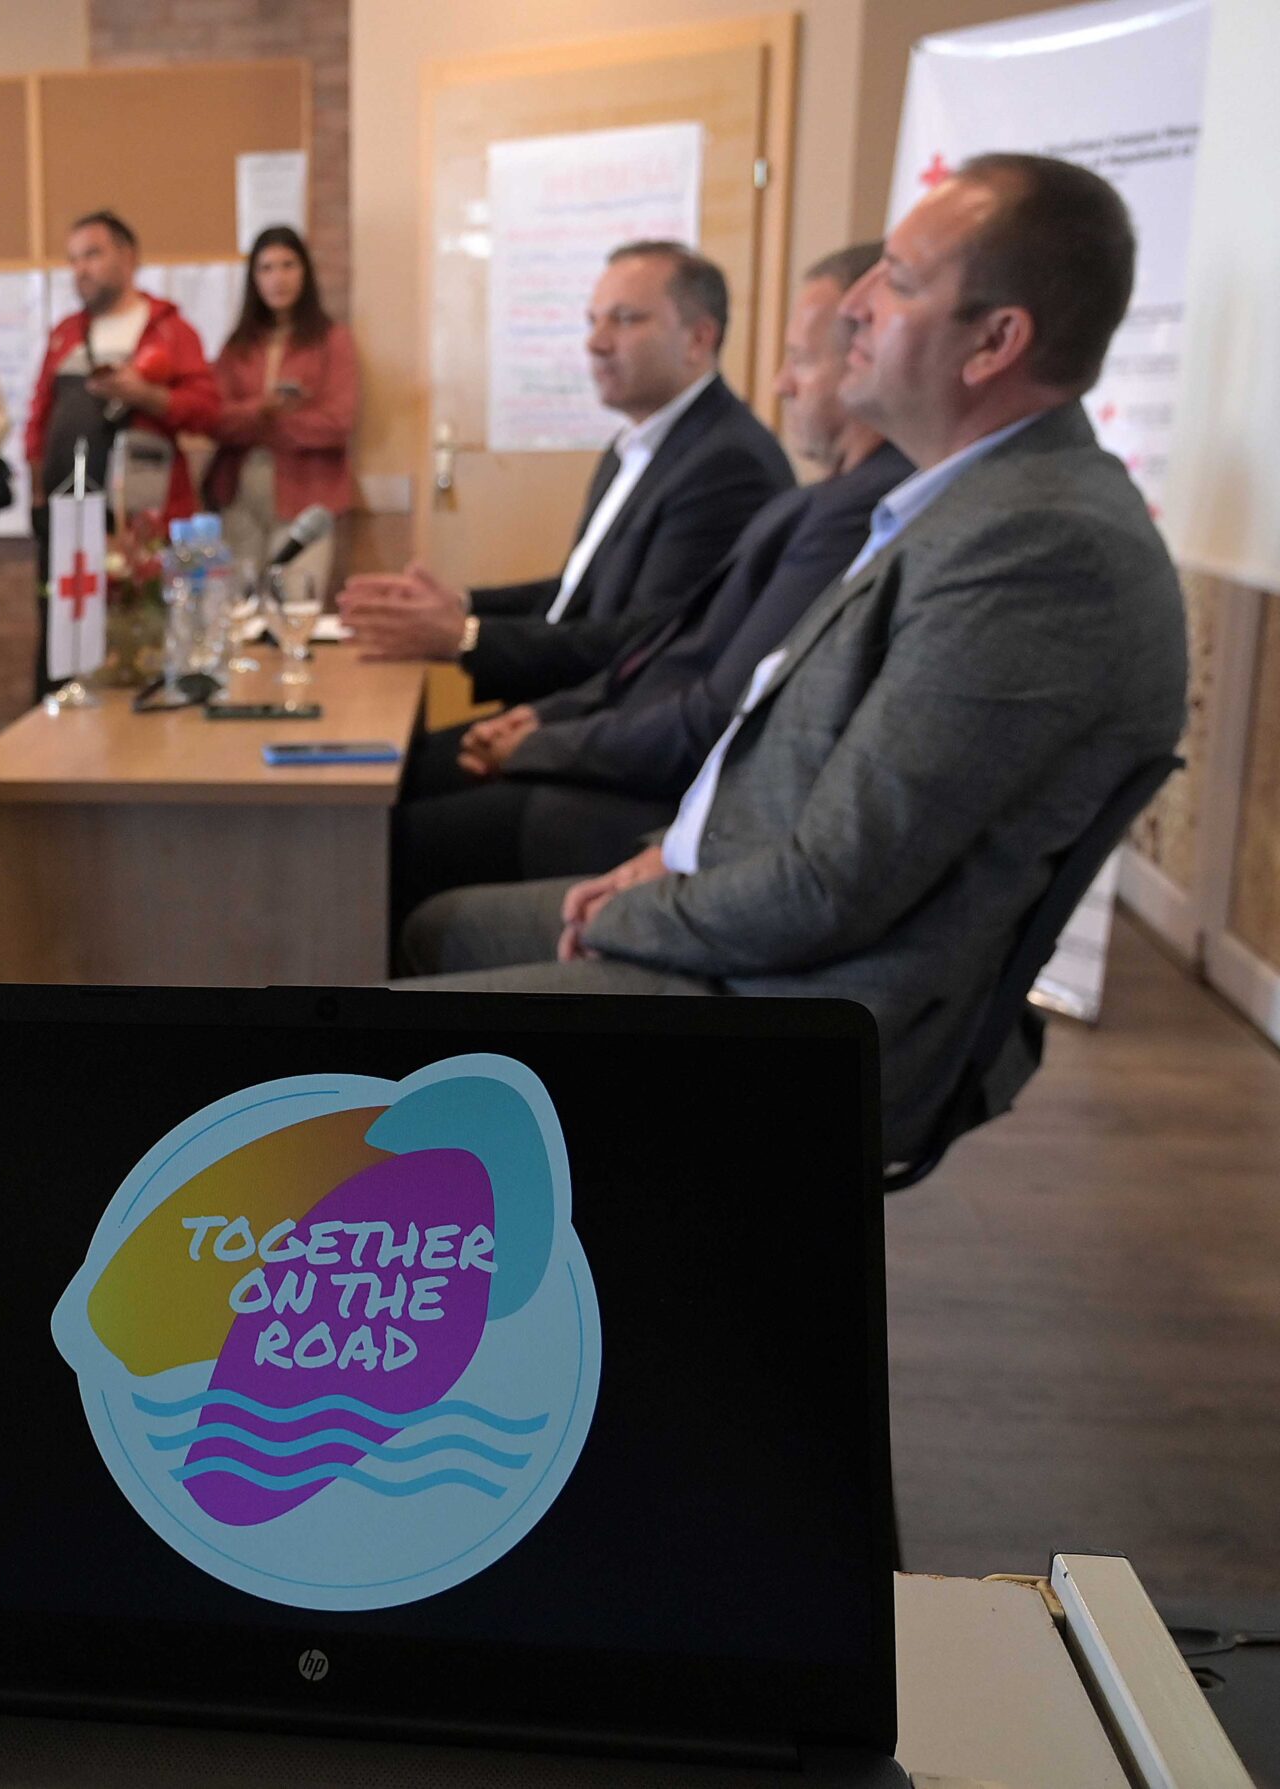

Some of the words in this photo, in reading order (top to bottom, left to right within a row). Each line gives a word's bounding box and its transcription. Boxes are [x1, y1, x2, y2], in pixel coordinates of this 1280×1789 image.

[182, 1215, 498, 1273] TOGETHER
[228, 1268, 317, 1315] ON
[330, 1271, 449, 1321] THE
[254, 1319, 418, 1372] ROAD
[300, 1649, 327, 1680] hp
